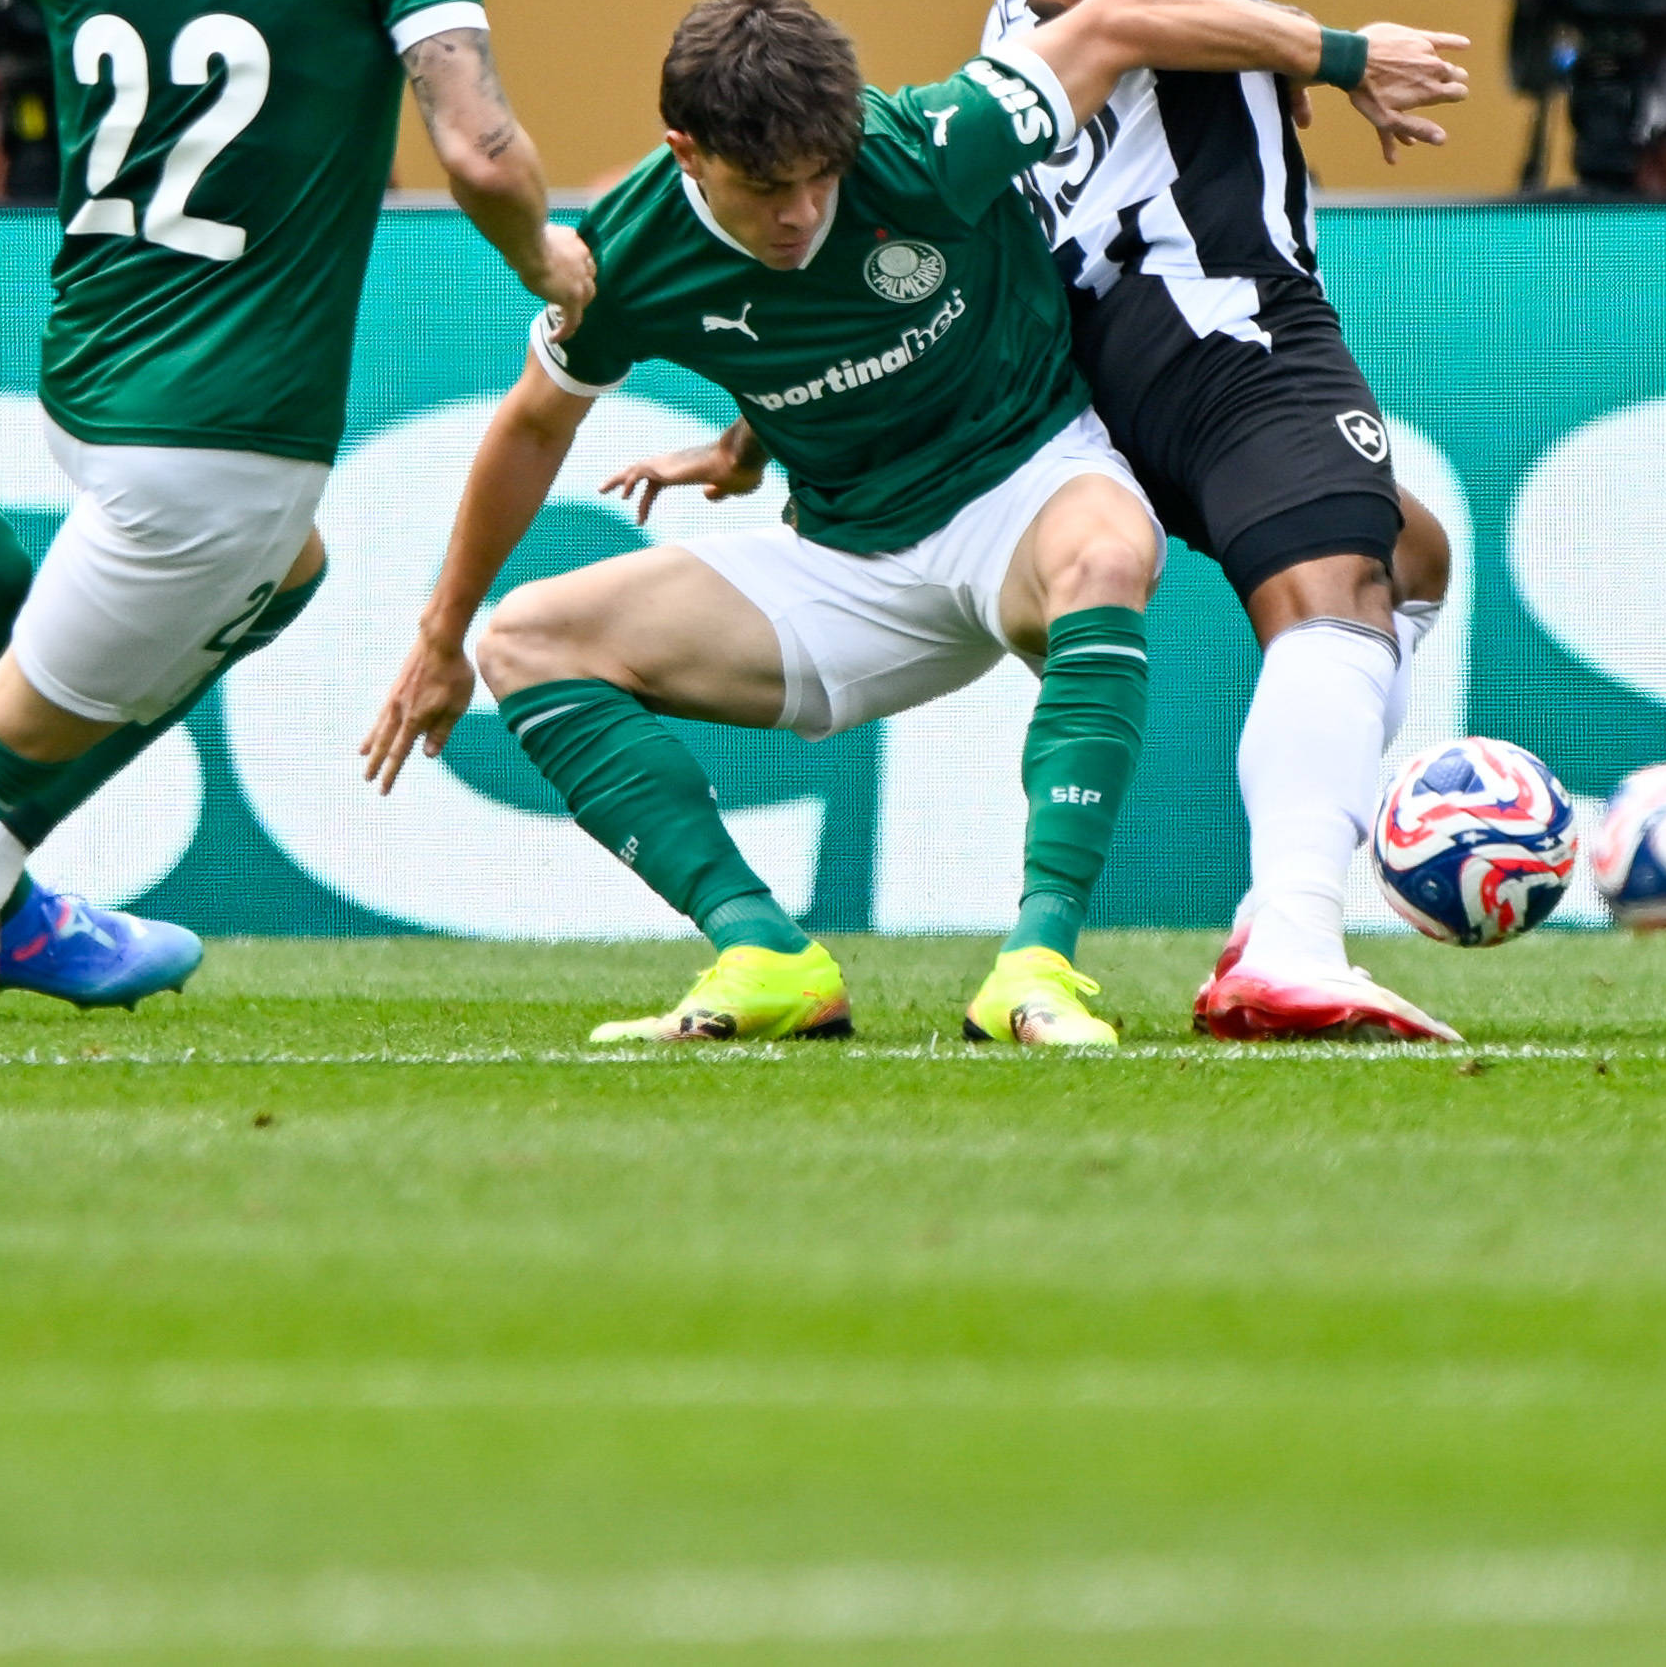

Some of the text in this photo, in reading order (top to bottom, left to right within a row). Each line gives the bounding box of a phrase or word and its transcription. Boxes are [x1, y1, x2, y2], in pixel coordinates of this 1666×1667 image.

[65, 13, 271, 262] 22
[873, 255, 941, 299] PALMEIRAS
[1051, 784, 1102, 806] SEP
